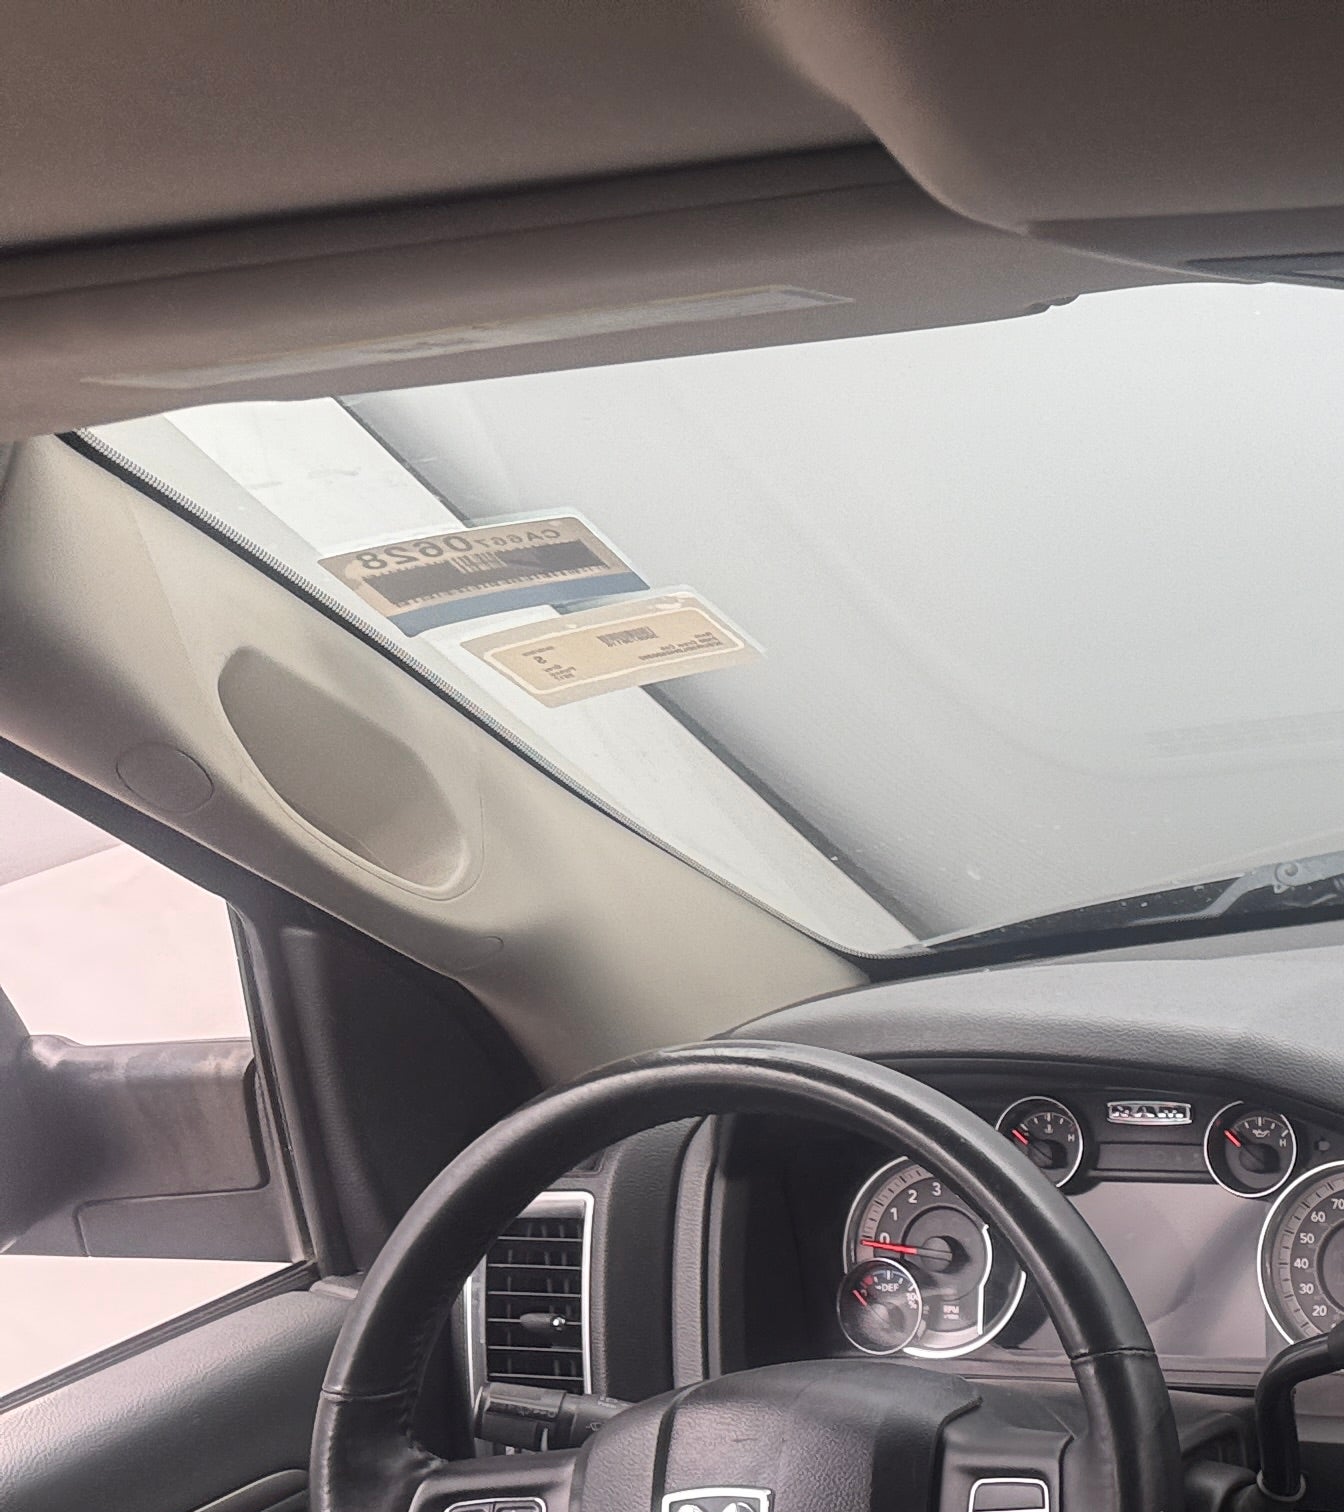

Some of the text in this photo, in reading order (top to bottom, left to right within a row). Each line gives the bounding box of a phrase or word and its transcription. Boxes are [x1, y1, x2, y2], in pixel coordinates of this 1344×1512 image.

[1067, 1133, 1076, 1143] H
[1279, 1138, 1288, 1148] H
[931, 1182, 942, 1197] 3
[908, 1189, 918, 1204] 2
[890, 1207, 898, 1221] 1
[1310, 1211, 1326, 1223] 60
[1300, 1232, 1315, 1244] 50
[1293, 1258, 1309, 1269] 40
[881, 1283, 900, 1292] DEF
[1299, 1283, 1315, 1294] 30
[1312, 1305, 1328, 1317] 20
